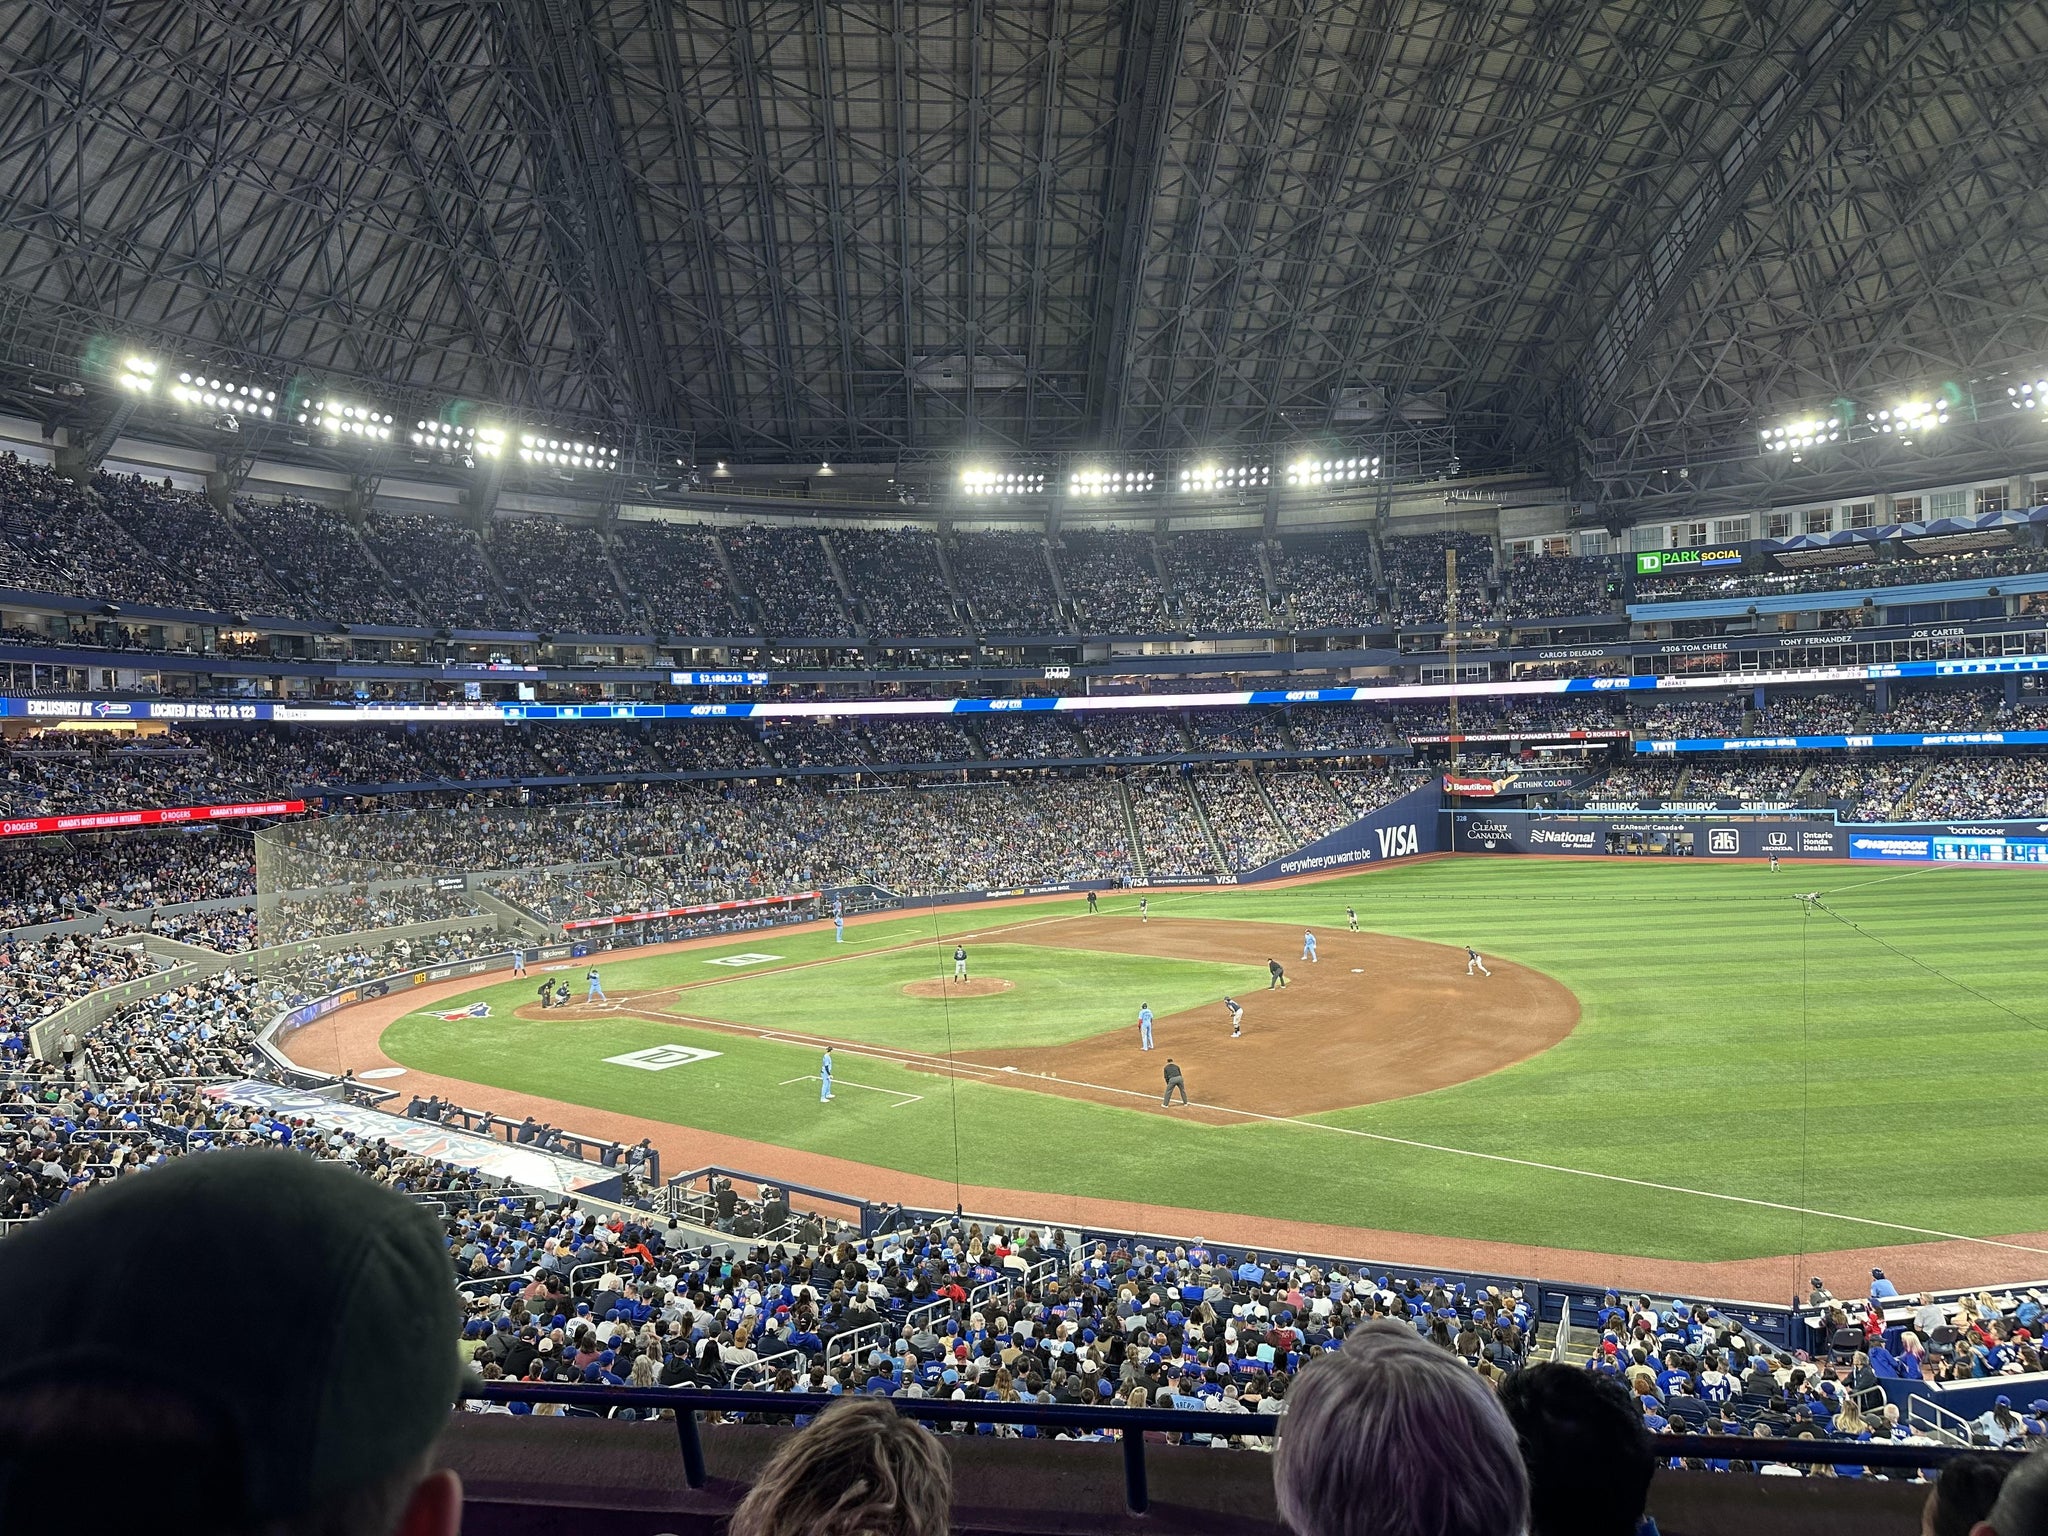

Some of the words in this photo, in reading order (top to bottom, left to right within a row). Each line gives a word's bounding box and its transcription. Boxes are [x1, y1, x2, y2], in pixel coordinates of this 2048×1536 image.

[1639, 556, 1659, 570] TD
[1663, 551, 1700, 563] PARK
[1701, 550, 1741, 560] SOCIAL
[1932, 628, 1965, 636] CARTER
[1805, 636, 1852, 645] FERNANDEZ
[1539, 651, 1567, 659] CARLOS
[1592, 679, 1613, 689] 407
[1285, 691, 1304, 701] 407
[28, 701, 80, 715] EXCLUSIVELY
[82, 702, 93, 716] AT
[989, 700, 1008, 709] 407
[150, 704, 185, 717] LOCATED
[186, 705, 197, 717] AT
[198, 705, 214, 718] SEC.
[215, 706, 229, 718] 112
[231, 705, 238, 718] &
[240, 706, 256, 718] 123
[690, 705, 711, 715] 407
[1845, 736, 1873, 746] YETI
[1651, 742, 1676, 751] YETI
[1453, 783, 1492, 791] BeautiTone
[1513, 780, 1543, 789] RETHINK
[1544, 779, 1572, 788] COLOUR
[210, 807, 232, 816] CANADA'S
[233, 806, 246, 814] MOST
[247, 805, 266, 813] RELIABLE
[267, 804, 286, 812] INTERNET
[1583, 801, 1640, 811] SUBWAY
[1660, 801, 1718, 811] SUBWAY
[168, 811, 191, 819] ROGERS
[57, 818, 81, 828] CANADA'S
[81, 817, 96, 826] MOST
[96, 815, 119, 825] RELIABLE
[119, 814, 142, 823] INTERNET
[11, 822, 38, 831] ROGERS
[1472, 822, 1508, 833] CLEARLY
[1467, 830, 1512, 840] CANADIAN
[1375, 824, 1419, 859] VISA
[1280, 856, 1324, 873] everywhere
[1323, 854, 1337, 868] you
[1336, 852, 1354, 864] want
[1354, 850, 1362, 860] to
[1362, 848, 1371, 859] be
[1131, 878, 1149, 887] VISA
[1215, 875, 1238, 884] VISA
[1030, 886, 1057, 894] BASELINE
[629, 1048, 698, 1064] TD
[1708, 1387, 1725, 1402] 11
